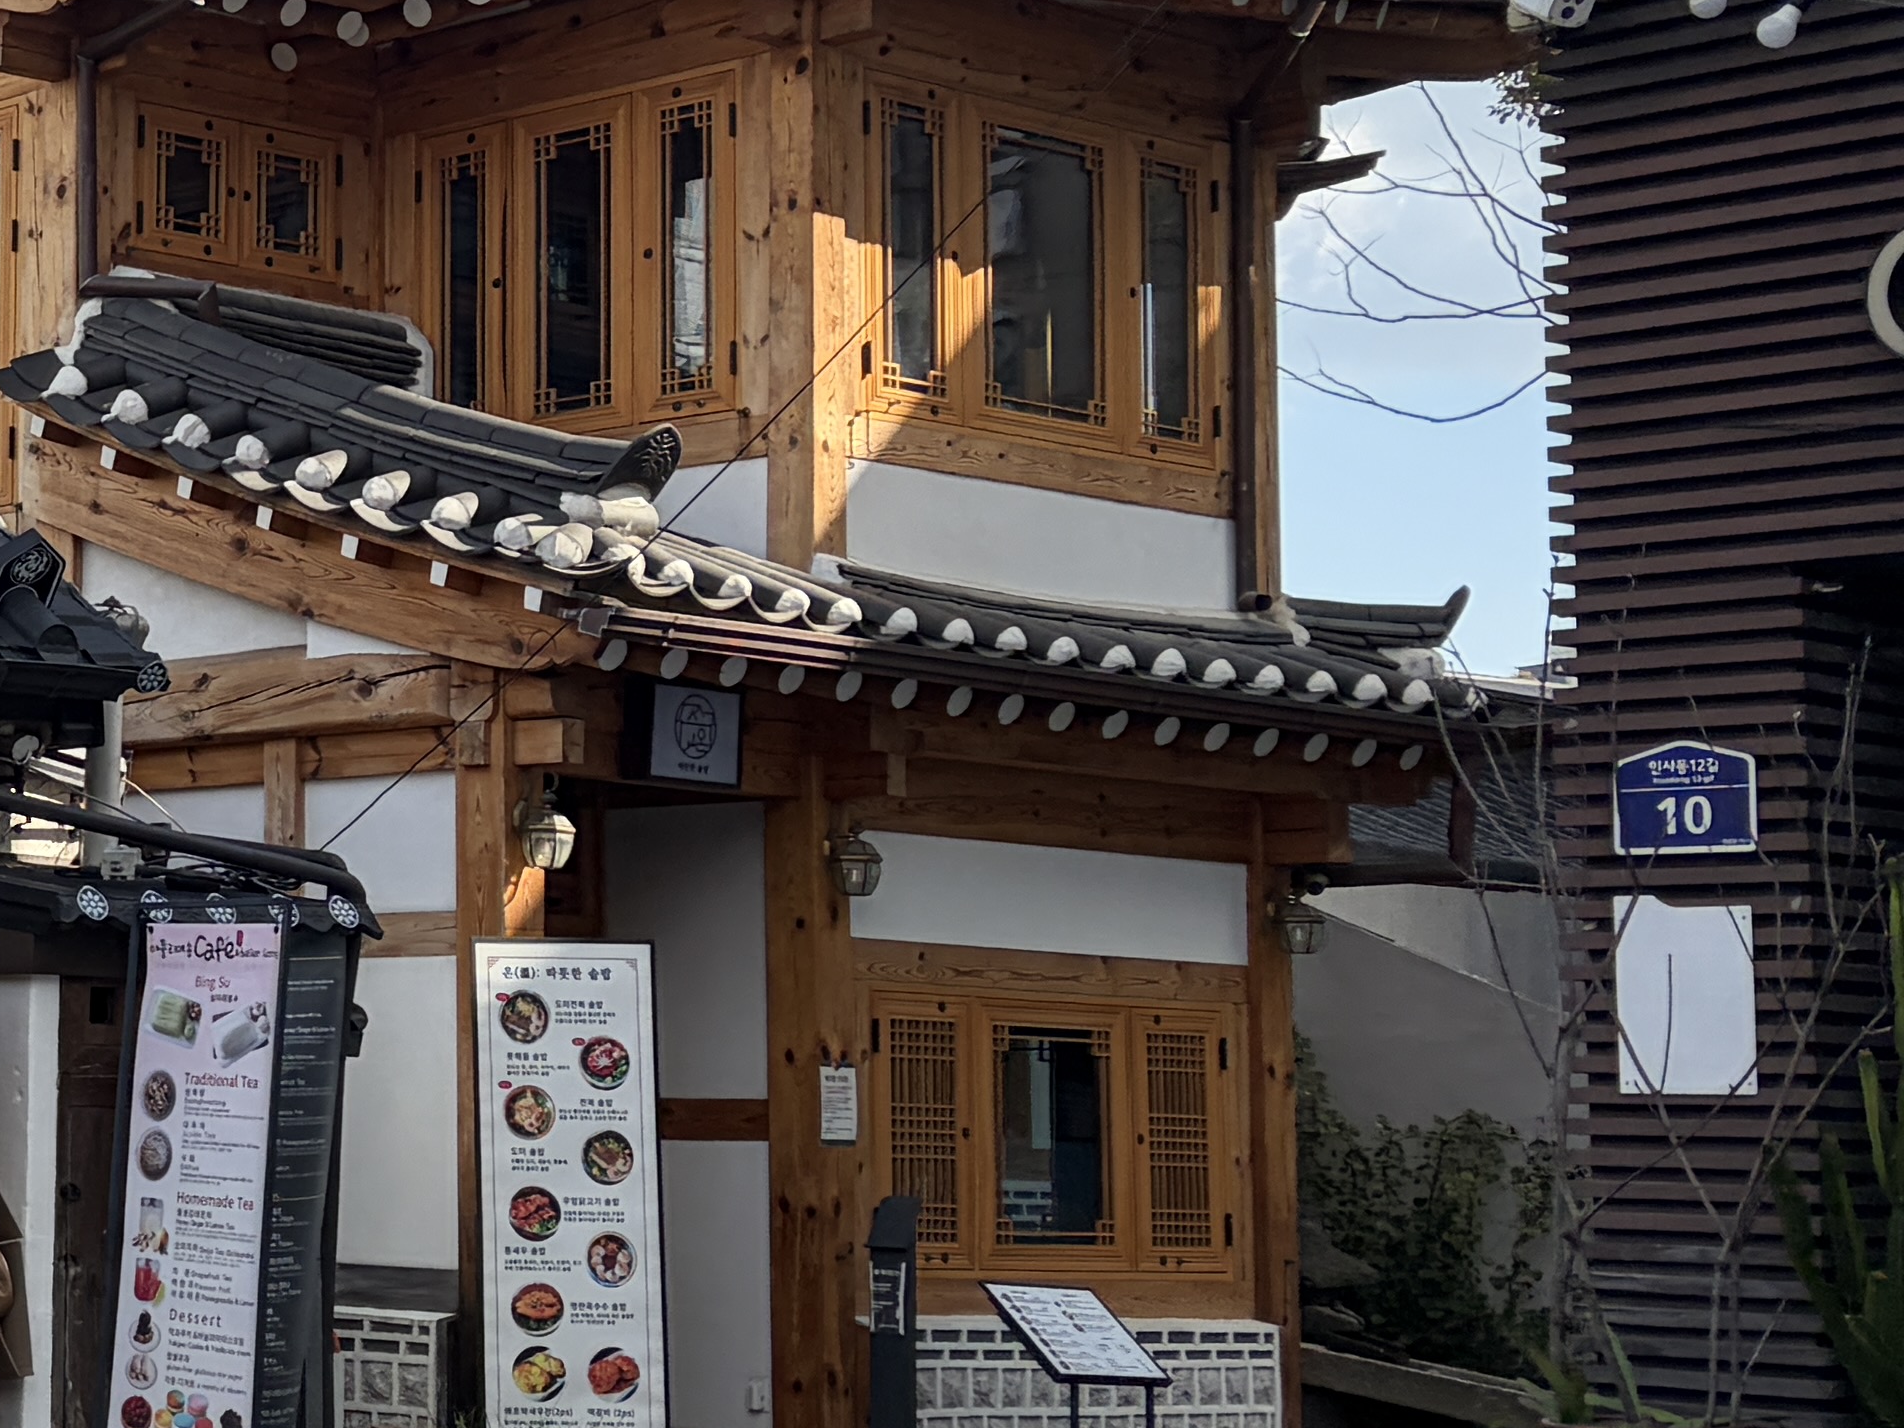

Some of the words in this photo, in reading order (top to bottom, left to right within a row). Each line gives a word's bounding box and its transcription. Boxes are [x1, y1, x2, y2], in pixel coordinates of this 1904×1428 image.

[1656, 795, 1713, 836] 10
[184, 1071, 239, 1088] Traditional
[240, 1074, 259, 1090] Tea
[168, 1307, 222, 1329] Dessert
